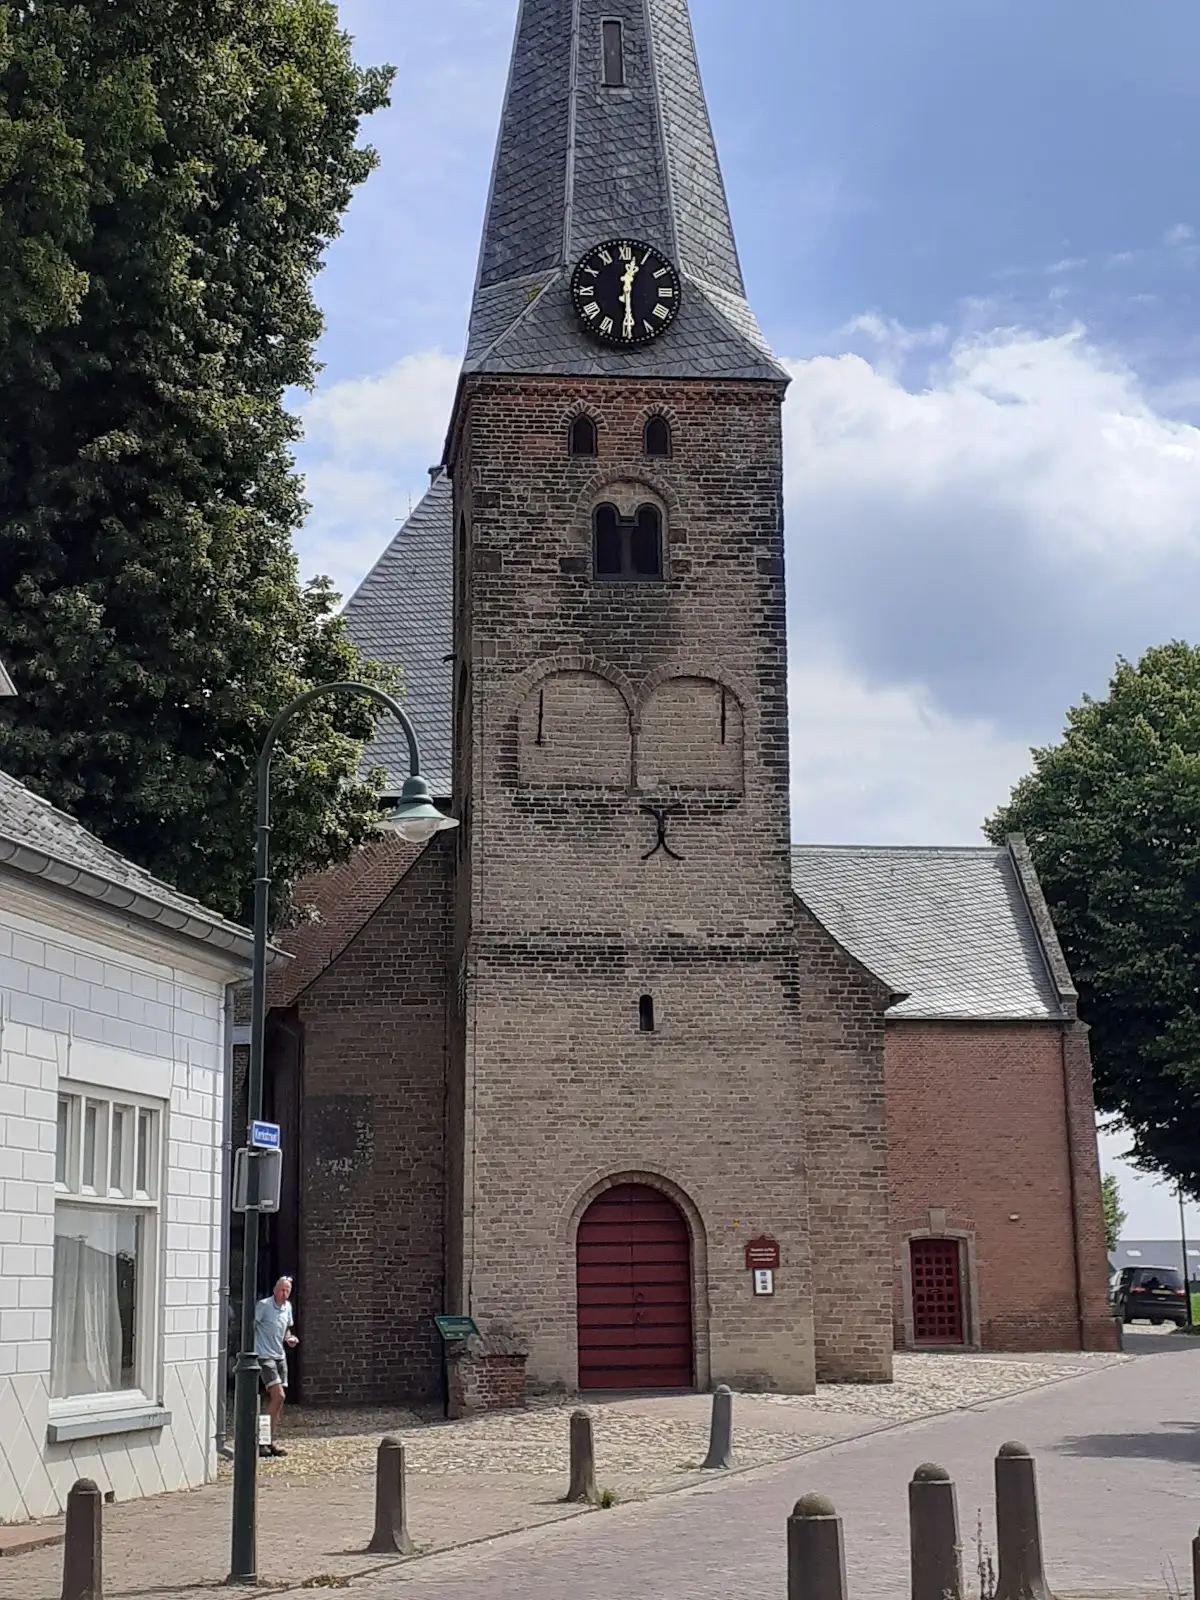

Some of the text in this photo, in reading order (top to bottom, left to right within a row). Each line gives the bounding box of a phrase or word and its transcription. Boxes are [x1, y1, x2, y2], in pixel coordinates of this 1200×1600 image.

[598, 250, 613, 266] XI
[618, 244, 631, 260] XII
[640, 250, 651, 265] I
[584, 265, 599, 278] X
[652, 267, 667, 279] II
[579, 285, 594, 296] IX
[658, 287, 673, 297] III
[583, 301, 601, 320] VIII
[652, 303, 670, 320] IIII
[599, 316, 614, 334] VII
[643, 319, 654, 333] V
